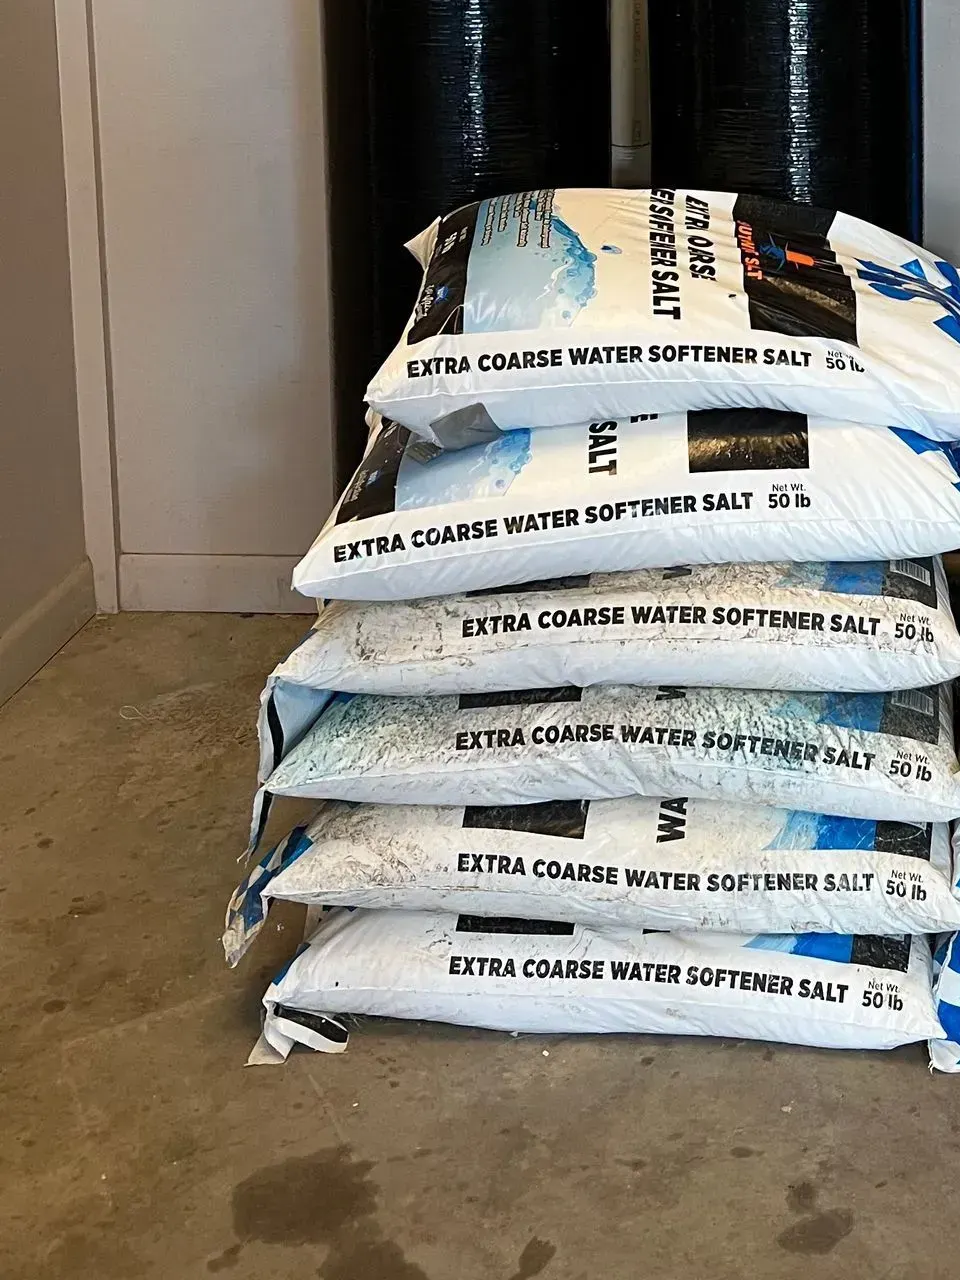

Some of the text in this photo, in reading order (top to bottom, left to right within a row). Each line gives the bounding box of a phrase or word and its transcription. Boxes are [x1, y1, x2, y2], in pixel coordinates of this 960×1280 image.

[651, 270, 681, 320] SALT
[407, 345, 812, 378] EXTRA COARSE WATER SOFTENER SALT
[825, 357, 846, 371] 50
[827, 350, 843, 358] Net
[588, 420, 618, 476] SALT
[772, 483, 788, 492] Net
[768, 493, 811, 509] 50 lb
[333, 492, 753, 563] EXTRA COARSE WATER SOFTENER SALT
[462, 605, 881, 638] EXTRA COARSE WATER SOFTENER SALT
[900, 612, 915, 623] Net
[894, 623, 935, 642] 50 lb
[456, 724, 876, 771] EXTRA COARSE WATER SOFTENER SALT
[896, 750, 912, 761] Net
[888, 759, 932, 782] 50 lb
[457, 853, 874, 892] EXTRA COARSE WATER SOFTENER SALT
[891, 869, 906, 881] Net
[885, 880, 927, 902] 50 lb
[448, 955, 849, 1004] EXTRA COARSE WATER SOFTENER SALT
[868, 980, 883, 991] Net
[861, 990, 904, 1011] 50 lb
